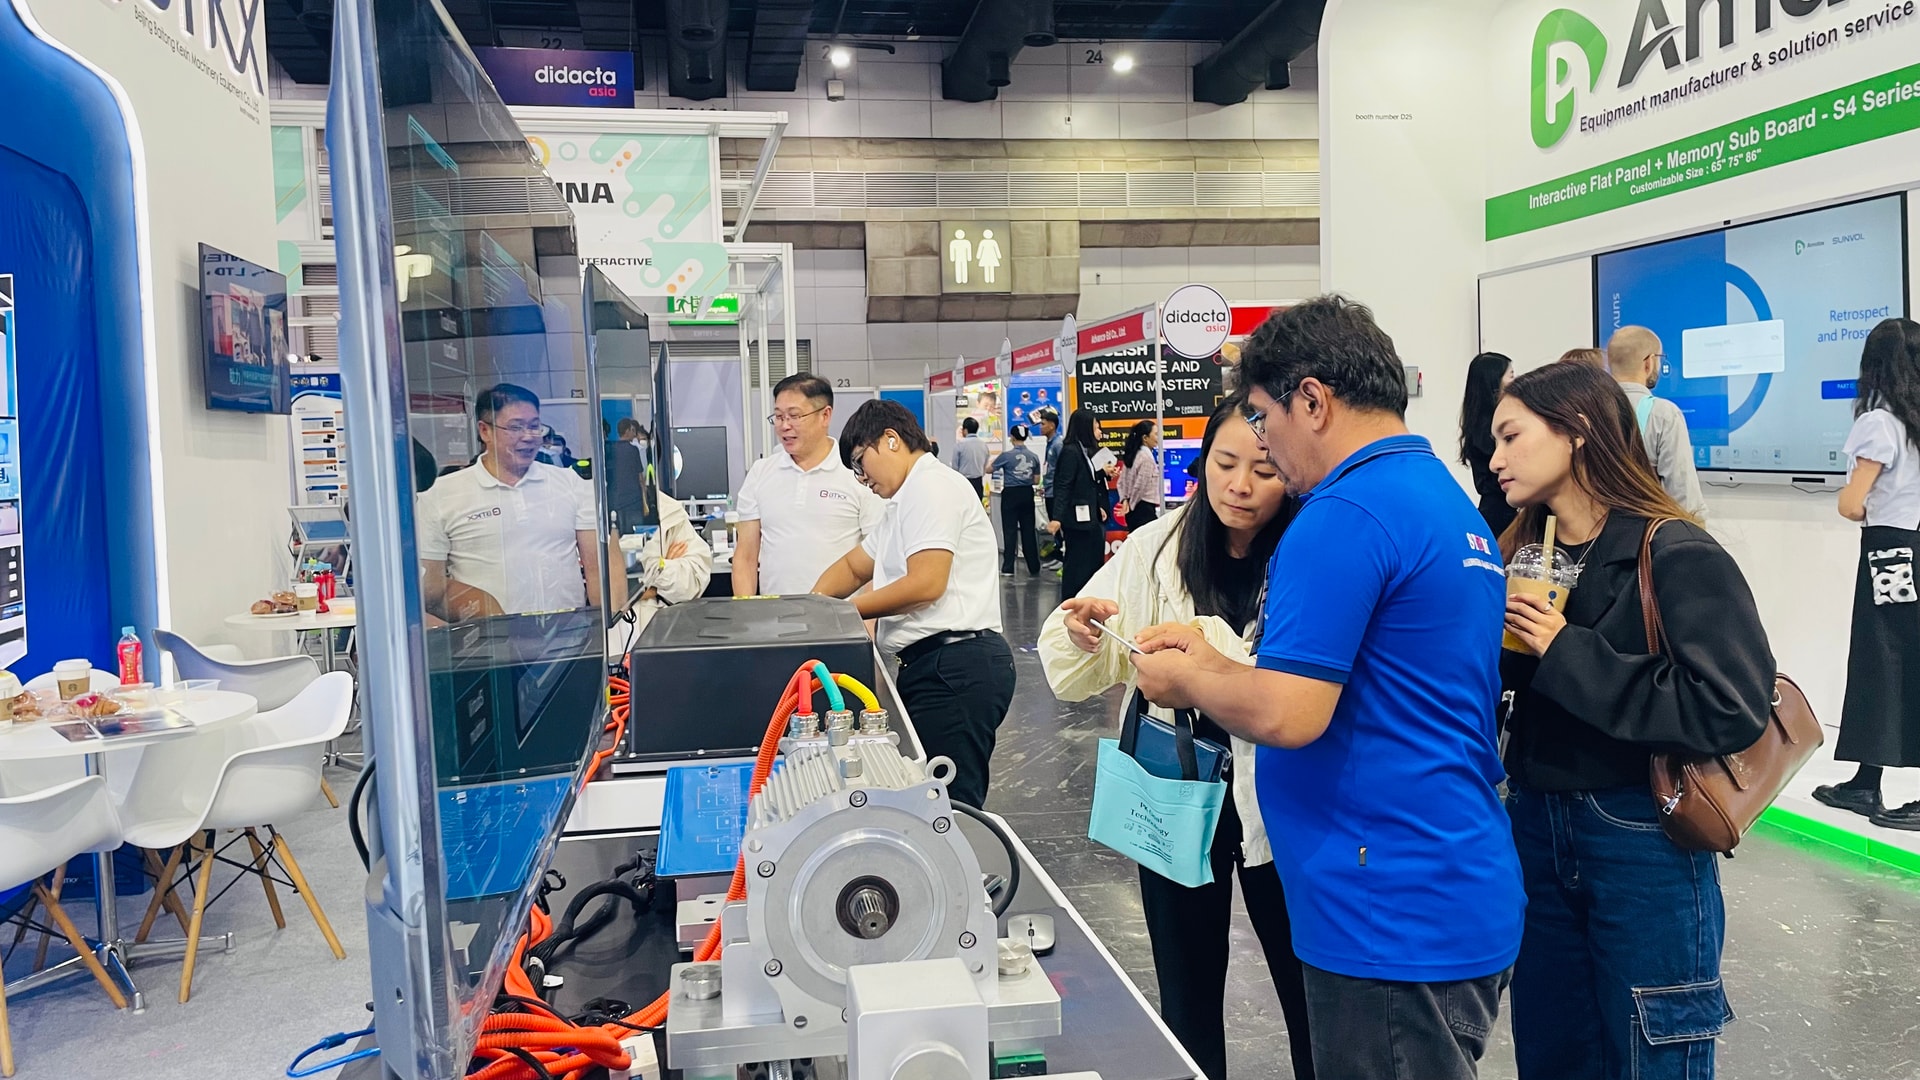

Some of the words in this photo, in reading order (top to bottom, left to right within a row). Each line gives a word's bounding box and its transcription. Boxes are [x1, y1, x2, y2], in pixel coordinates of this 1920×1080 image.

[1086, 49, 1103, 63] 24
[1580, 95, 1646, 132] Equipment
[1650, 62, 1746, 108] manufacturer
[1751, 53, 1762, 71] &
[1768, 27, 1838, 65] solution
[1844, 0, 1914, 37] service
[534, 65, 616, 85] didacta
[589, 86, 616, 97] asia
[1529, 181, 1587, 209] Interactive
[1590, 174, 1613, 193] Flat
[1615, 158, 1651, 185] Panel
[1654, 158, 1663, 171] +
[1667, 140, 1725, 170] Memory
[1729, 127, 1760, 151] Sub
[1764, 107, 1816, 141] Board
[1833, 95, 1857, 121] S4
[1862, 80, 1920, 113] Series
[1630, 172, 1683, 196] Customizable
[1685, 165, 1704, 180] Size
[1711, 158, 1726, 173] 65"
[1728, 154, 1744, 168] 75"
[1745, 148, 1762, 163] 86"
[1832, 233, 1864, 245] SUNVOL
[1166, 309, 1226, 323] didacta
[1829, 305, 1889, 323] Retrospect
[1205, 324, 1226, 332] asia
[1817, 329, 1837, 342] and
[1082, 361, 1168, 376] LANGUAGE
[1171, 361, 1200, 373] AND
[837, 379, 851, 388] 23
[1083, 381, 1143, 394] READING
[1147, 378, 1210, 393] MASTERY
[1084, 401, 1109, 414] Fast
